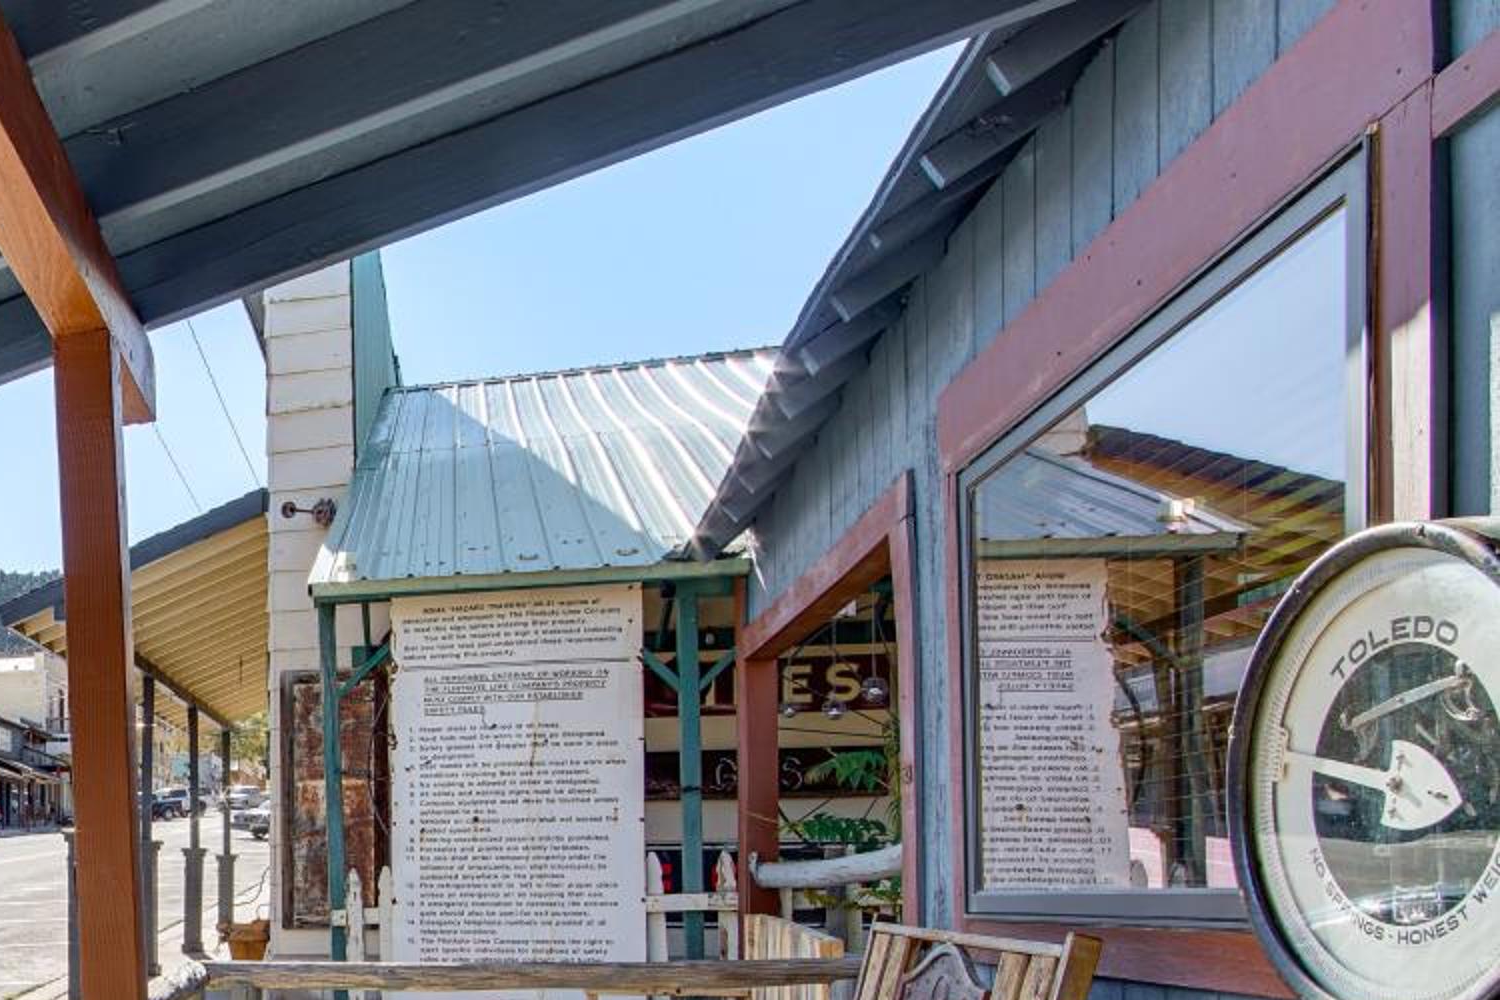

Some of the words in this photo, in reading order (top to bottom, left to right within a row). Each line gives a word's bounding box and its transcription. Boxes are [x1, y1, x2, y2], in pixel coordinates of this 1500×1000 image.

[1329, 614, 1460, 680] TOLEDO
[1325, 881, 1385, 941] SPRNGS
[1397, 906, 1469, 945] HONEST
